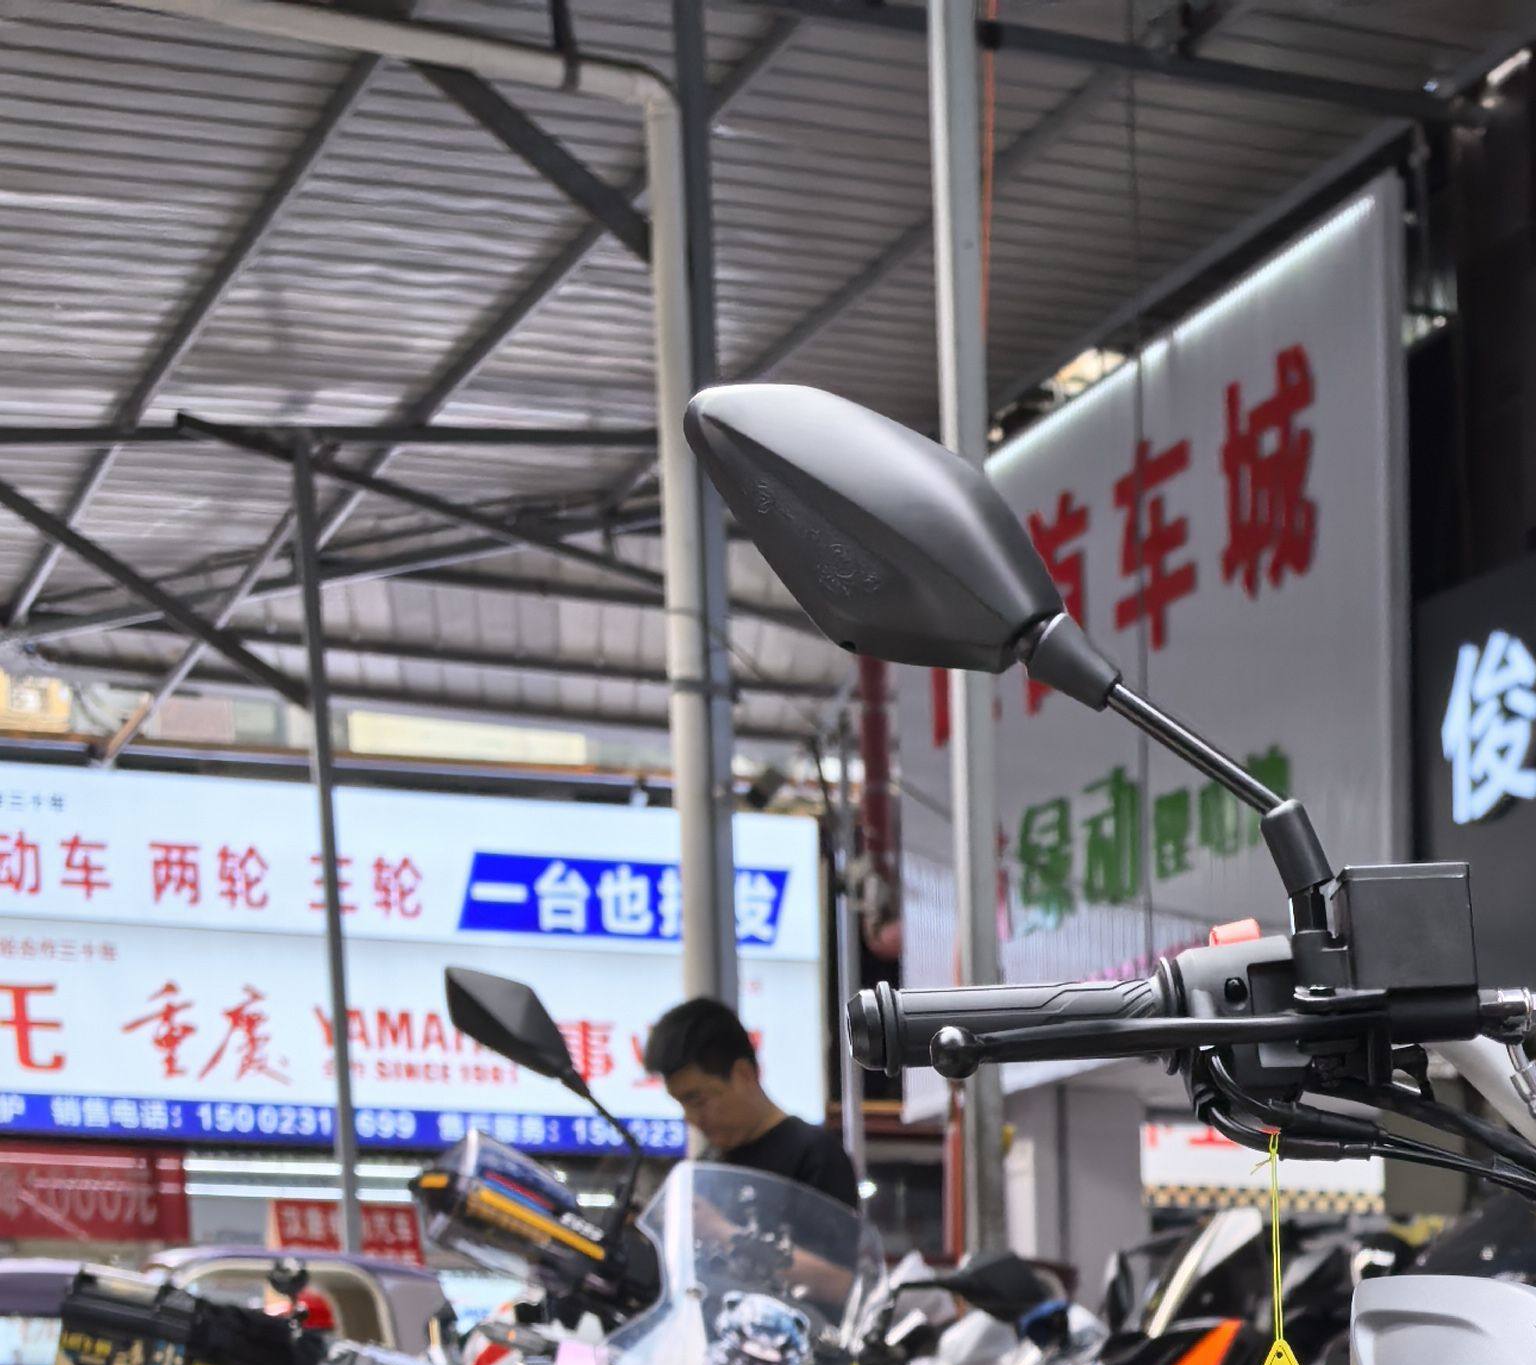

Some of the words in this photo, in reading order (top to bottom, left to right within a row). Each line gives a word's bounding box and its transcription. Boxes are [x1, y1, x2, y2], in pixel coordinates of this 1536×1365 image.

[148, 841, 270, 909] 两轮
[308, 854, 423, 919] 三轮
[313, 1006, 484, 1054] YAMA
[197, 1102, 415, 1138] 1500231699
